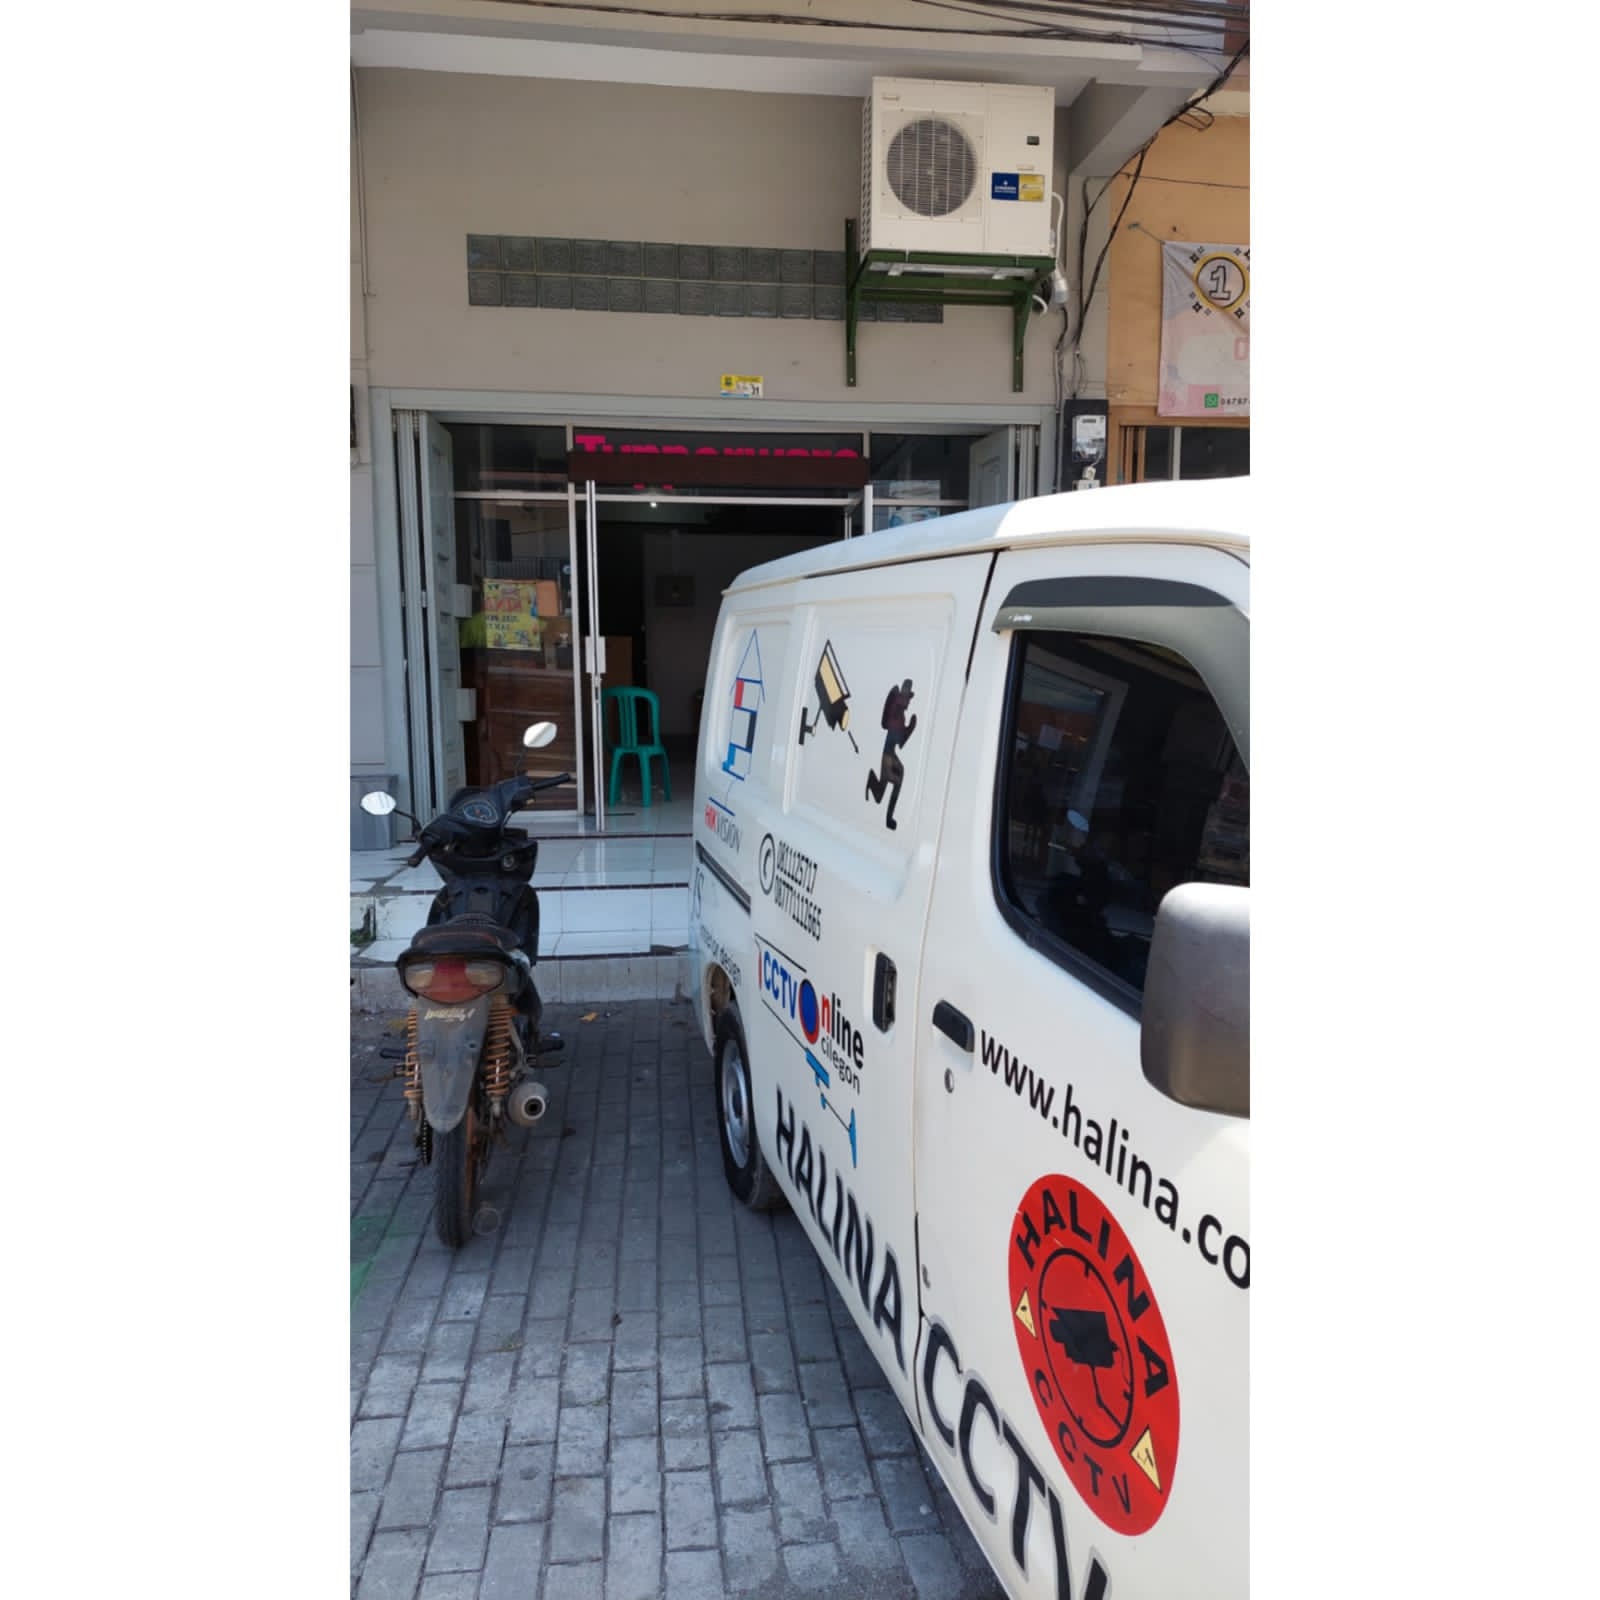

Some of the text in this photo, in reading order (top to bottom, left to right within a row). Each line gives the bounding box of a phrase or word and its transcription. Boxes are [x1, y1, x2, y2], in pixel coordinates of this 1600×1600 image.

[1208, 264, 1232, 301] 1
[763, 950, 798, 1020] CCTV
[820, 1034, 861, 1095] cilegon
[980, 1028, 1250, 1290] www.halina.co
[775, 1081, 1110, 1600] HALINA CCTV
[1015, 1187, 1170, 1400] HALINA
[1034, 1368, 1132, 1516] CCTV
